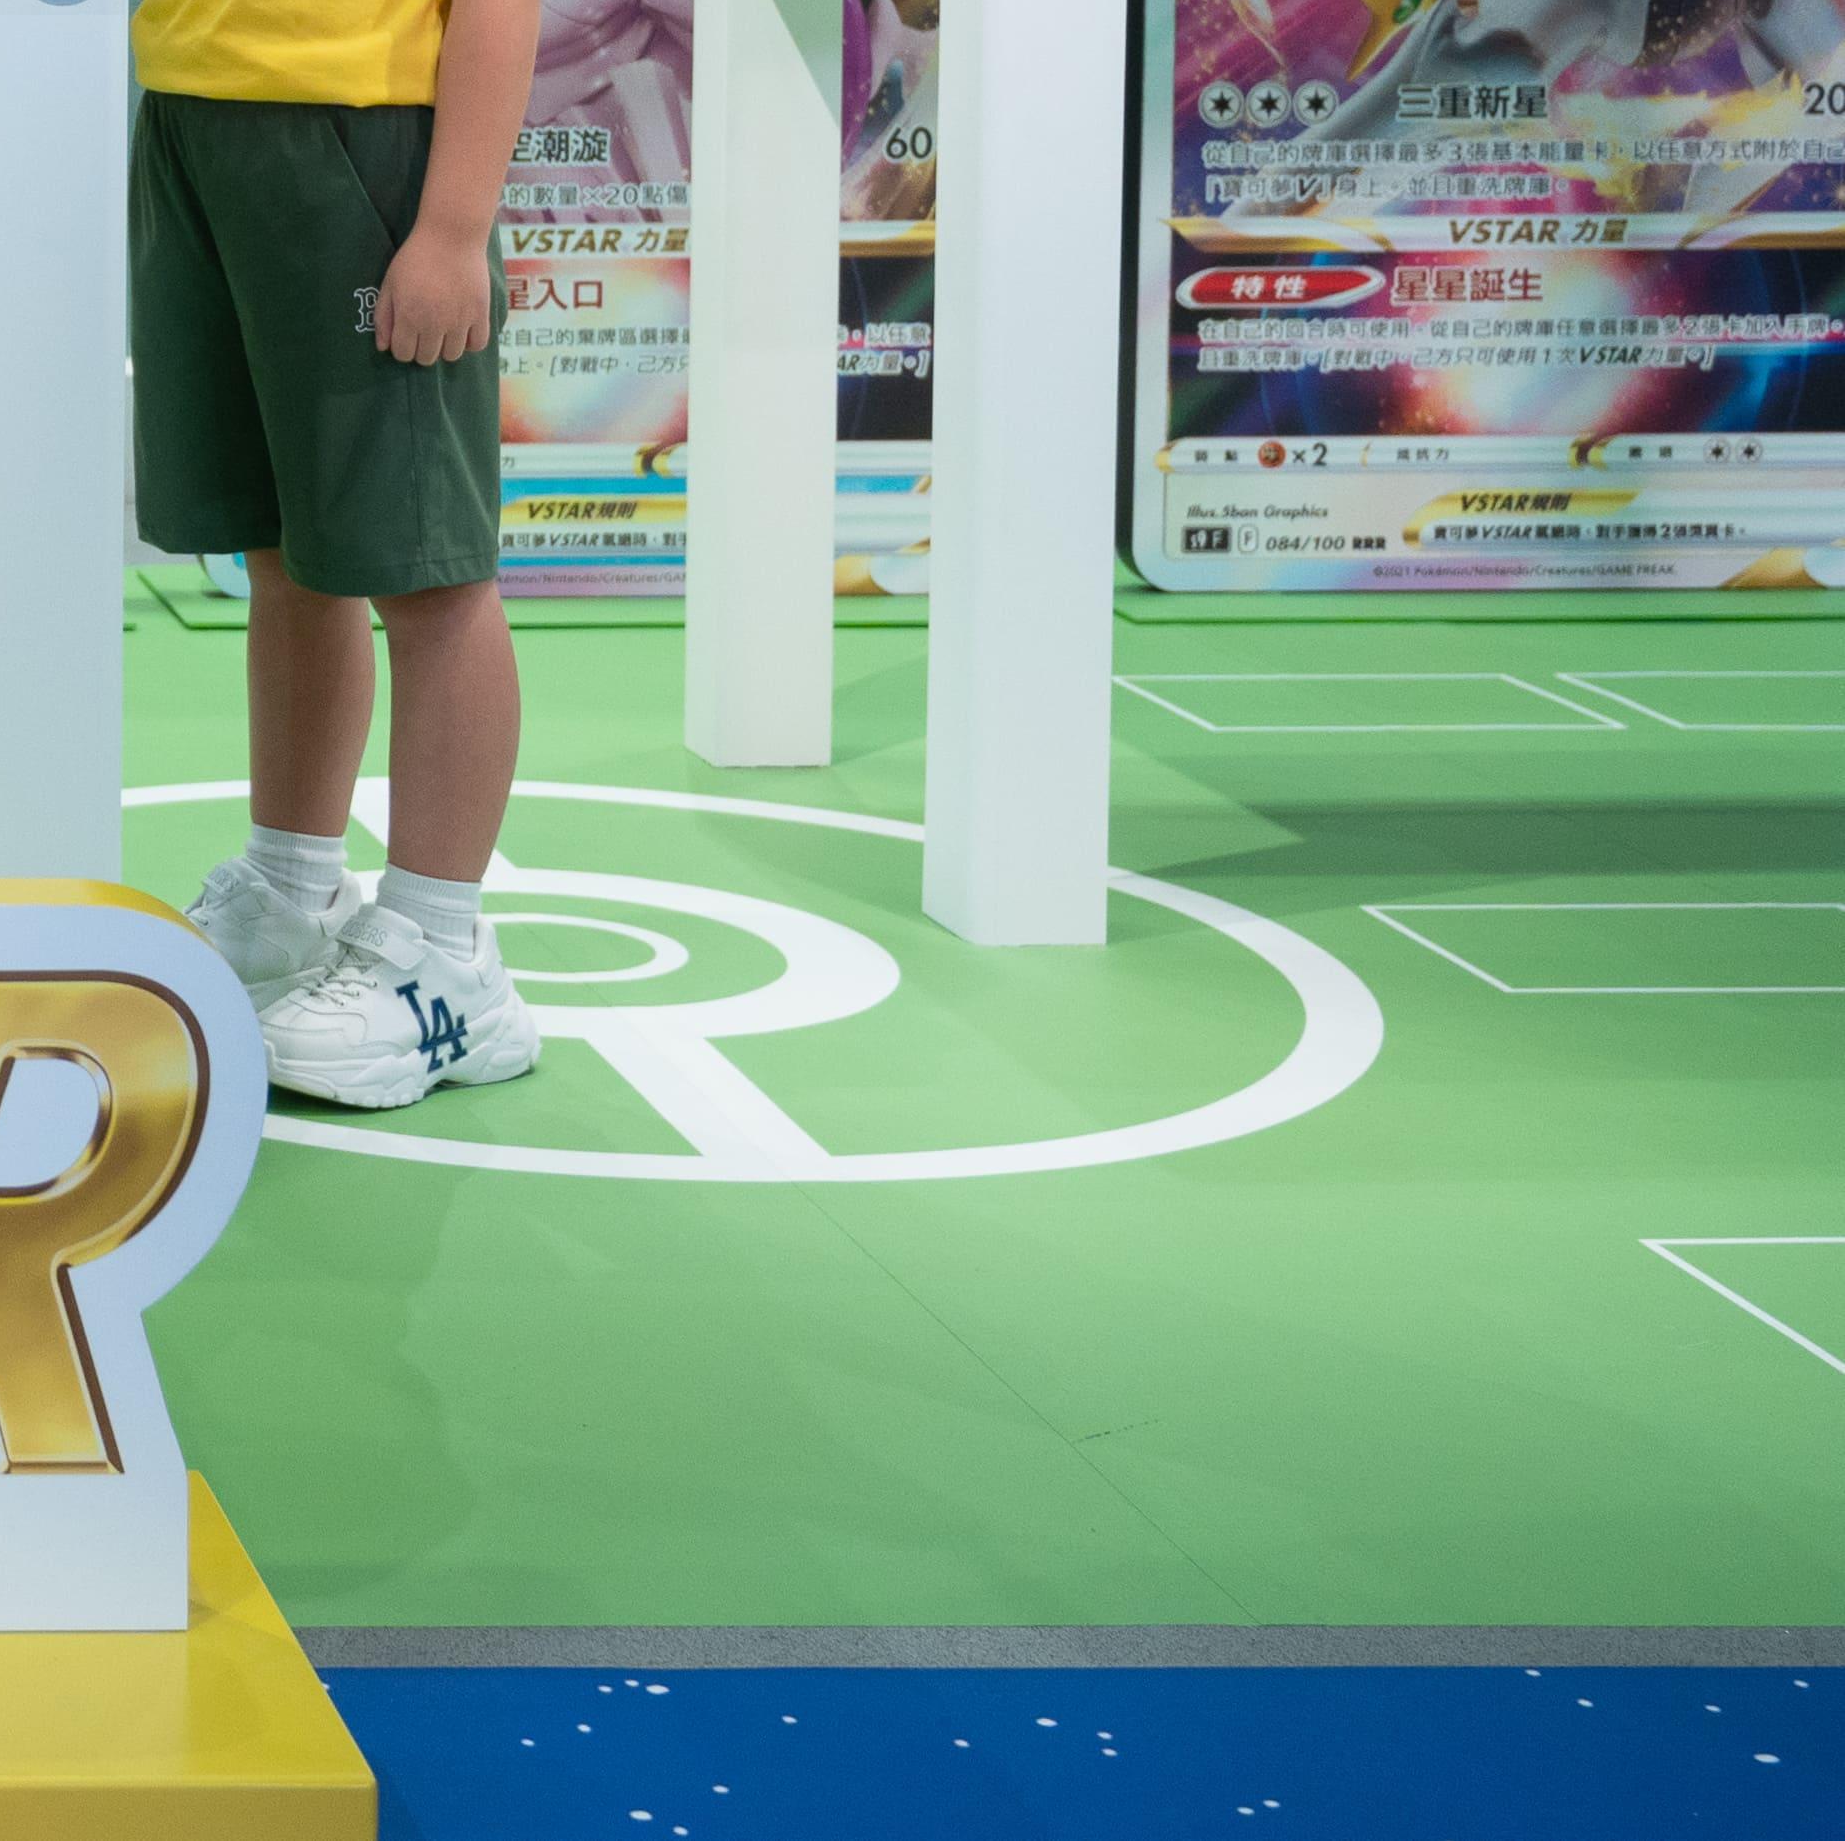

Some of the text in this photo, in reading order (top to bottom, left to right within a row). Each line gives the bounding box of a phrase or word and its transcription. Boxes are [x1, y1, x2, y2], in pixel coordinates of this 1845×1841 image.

[1399, 84, 1547, 120] 三重新星
[886, 126, 933, 160] 60
[511, 228, 622, 254] VSTAR
[1449, 219, 1629, 244] VSTAR 力量
[1231, 274, 1307, 299] 特性
[1394, 268, 1544, 302] 星星誕生
[396, 980, 468, 1093] LA
